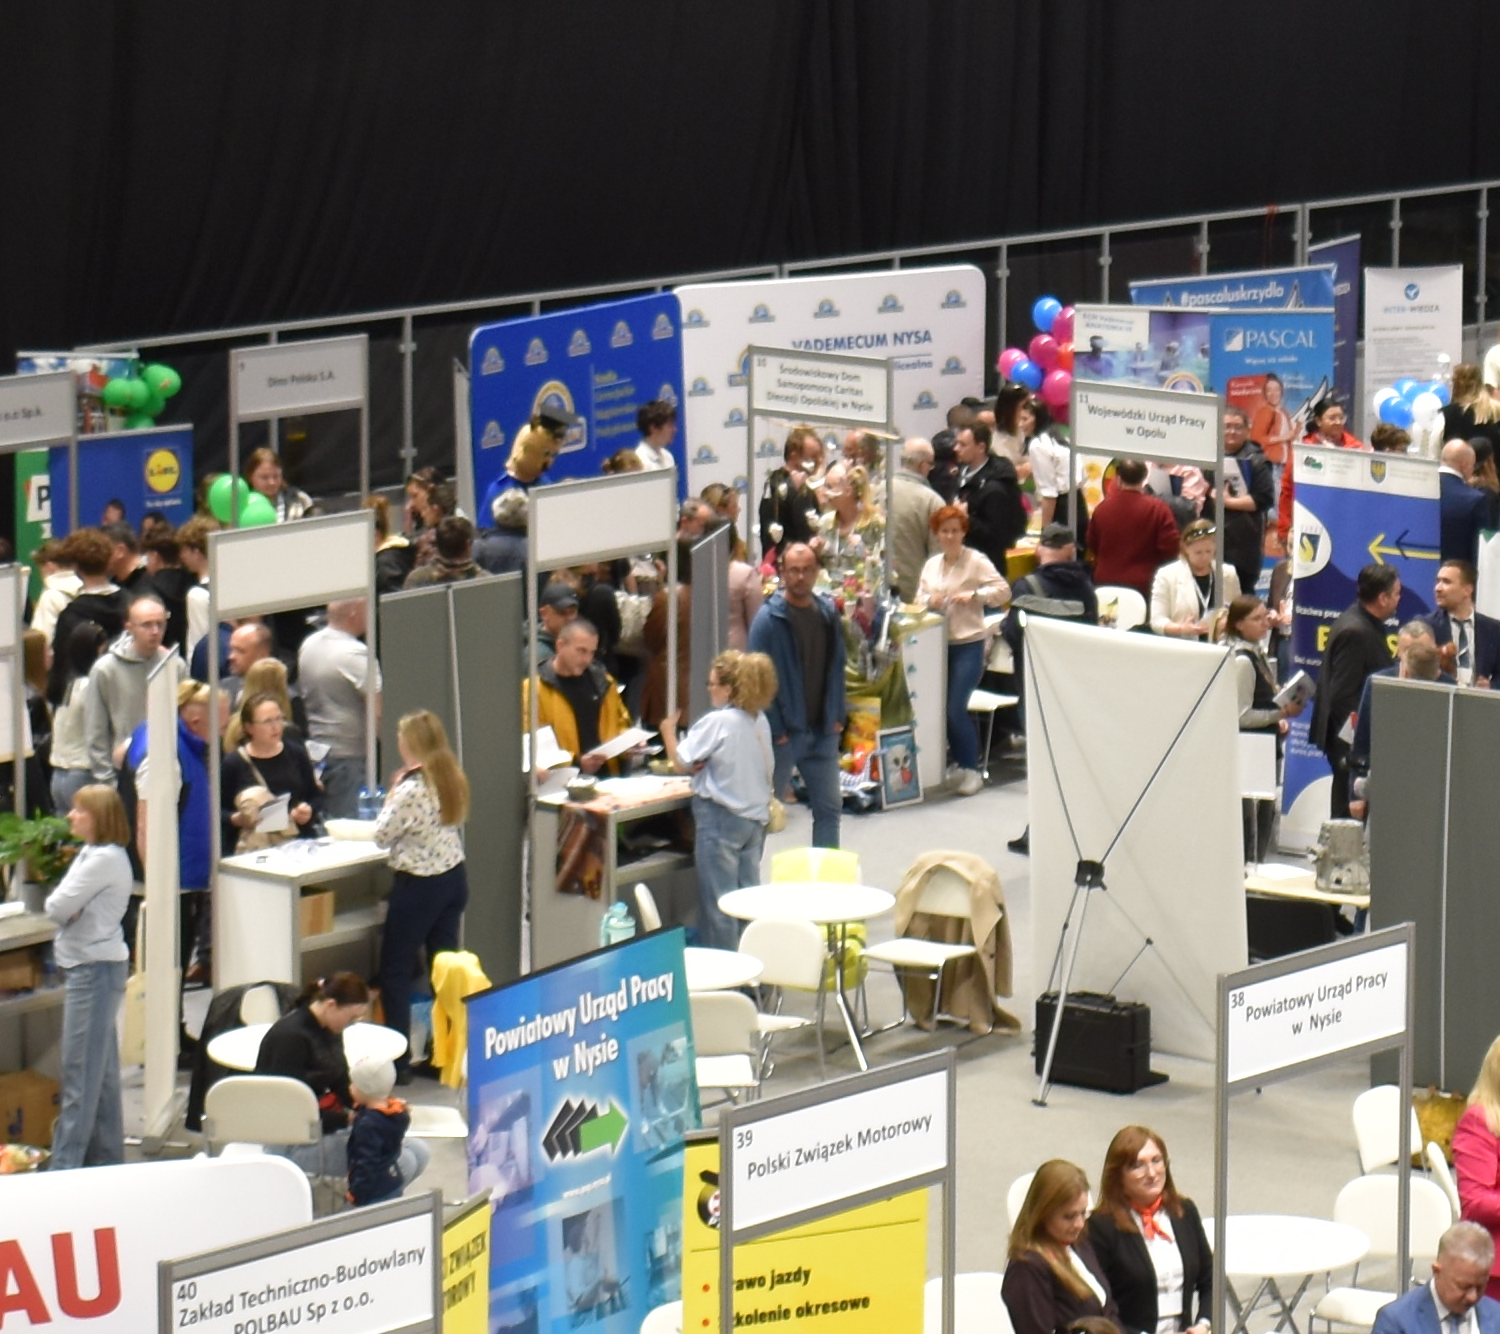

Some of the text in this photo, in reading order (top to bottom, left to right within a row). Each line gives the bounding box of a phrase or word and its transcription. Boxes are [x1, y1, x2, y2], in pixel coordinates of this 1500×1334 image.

[792, 330, 933, 352] VADEMECUM NYSA
[1244, 327, 1317, 350] PASCAL
[1087, 404, 1206, 431] Wojewódzki Urząd Pracy
[1137, 424, 1167, 441] Opolu
[1230, 992, 1245, 1010] 38
[1246, 970, 1390, 1025] Powiatowy Urząd Pracy
[484, 967, 674, 1060] Powiatowy Urząd Pracy
[1292, 1006, 1343, 1035] w Nysie
[553, 1036, 620, 1082] w Nysie
[734, 1130, 755, 1150] 39
[748, 1111, 934, 1181] Polski Związek Motorowy
[448, 1231, 487, 1274] ZWIĄZEK
[177, 1280, 198, 1301] 40
[178, 1242, 429, 1329] Zakład Techniczno-Budowlany
[769, 1265, 812, 1291] jazdy
[307, 1300, 329, 1327] Sp
[345, 1291, 376, 1313] o.o.
[795, 1295, 870, 1319] okresowe
